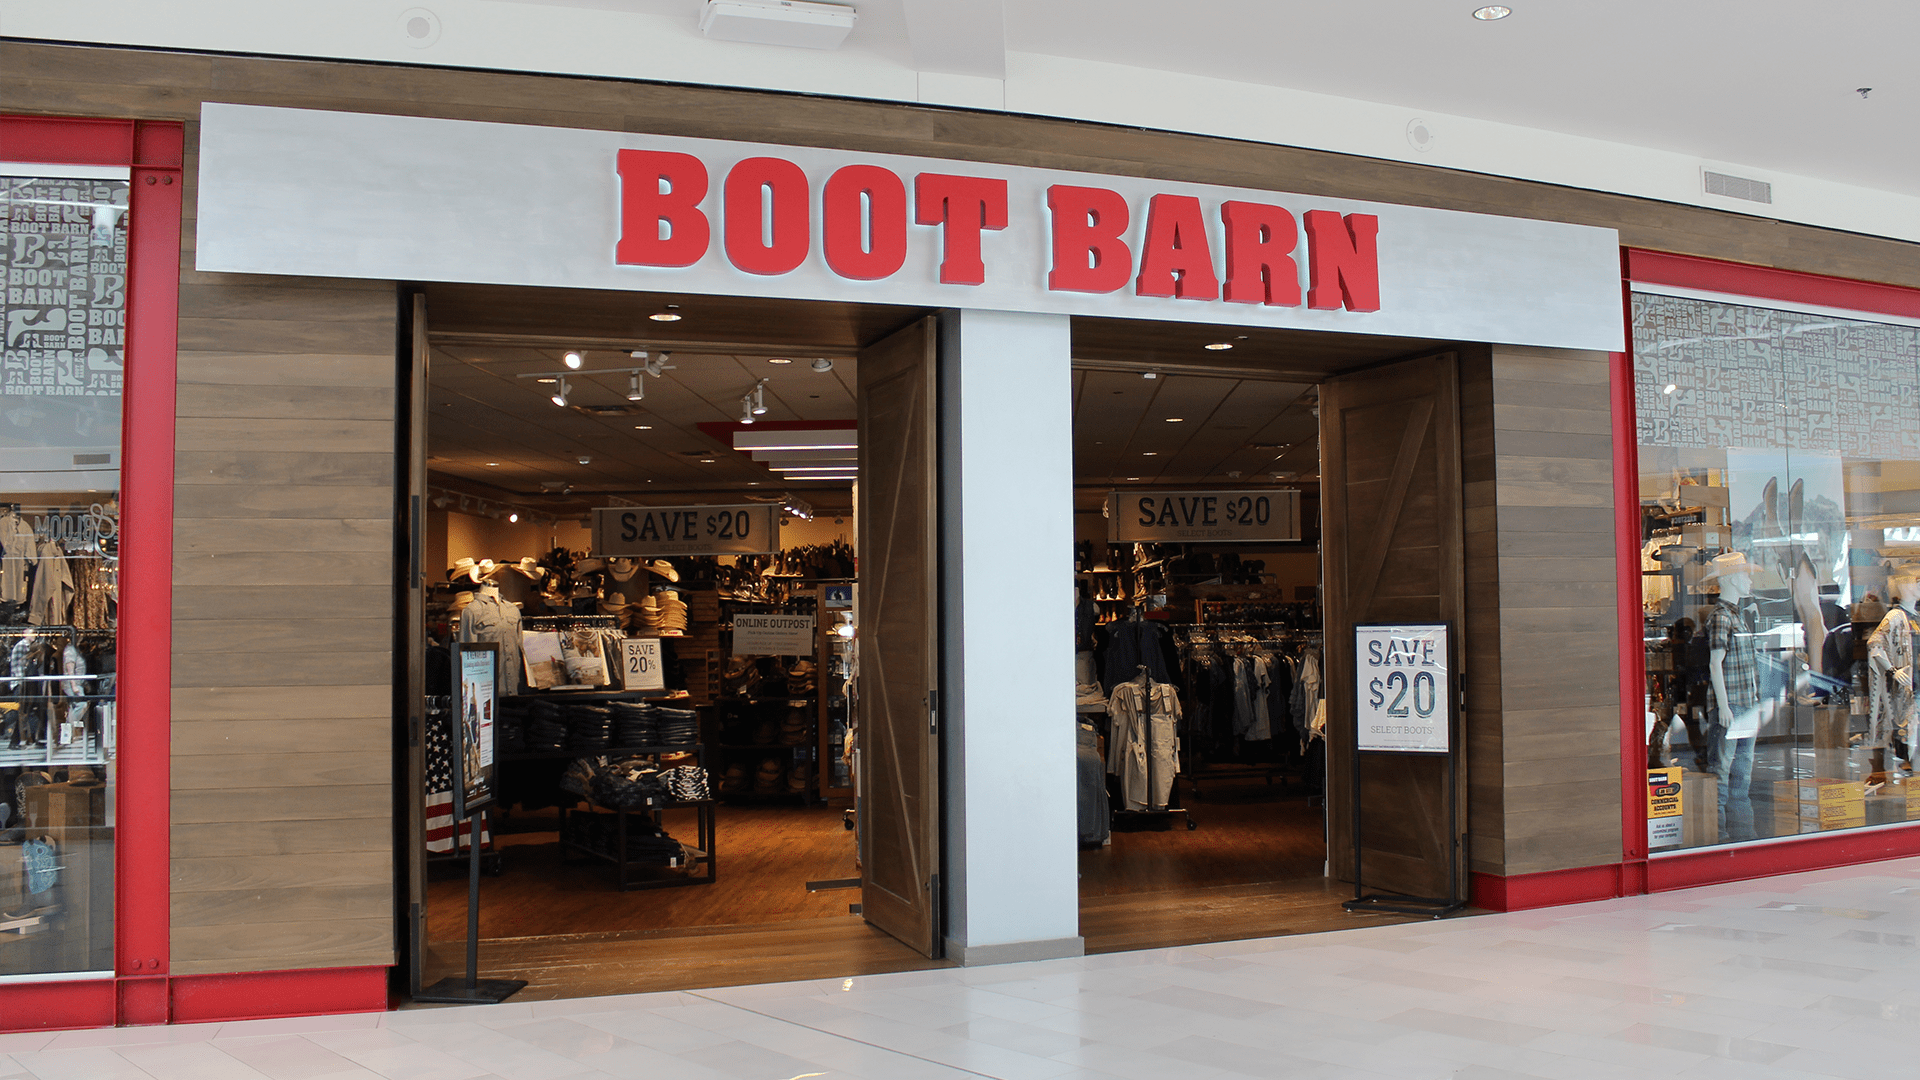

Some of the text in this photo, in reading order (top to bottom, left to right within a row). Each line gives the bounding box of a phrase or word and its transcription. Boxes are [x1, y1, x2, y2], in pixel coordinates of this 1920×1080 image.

[10, 222, 90, 235] BOOT BARN
[615, 148, 1381, 313] BOOT BARN
[69, 236, 89, 291] BARN
[91, 262, 127, 274] BOOT
[9, 269, 68, 286] BOOT
[8, 288, 67, 305] BARN
[68, 294, 87, 349] BOOT
[30, 350, 42, 385] BOOT
[42, 350, 55, 385] BARN
[5, 386, 44, 395] BOOT
[46, 386, 84, 395] BARN
[1138, 496, 1271, 528] SAVE $20
[620, 510, 750, 542] SAVE $20
[1177, 529, 1232, 537] SELECT BOOTS
[736, 618, 811, 629] ONLINE OUTPOST
[628, 644, 655, 656] SAVE
[1368, 639, 1435, 667] SAVE
[629, 656, 656, 674] 20%
[1369, 671, 1436, 719] $20
[1370, 725, 1402, 734] SELECT
